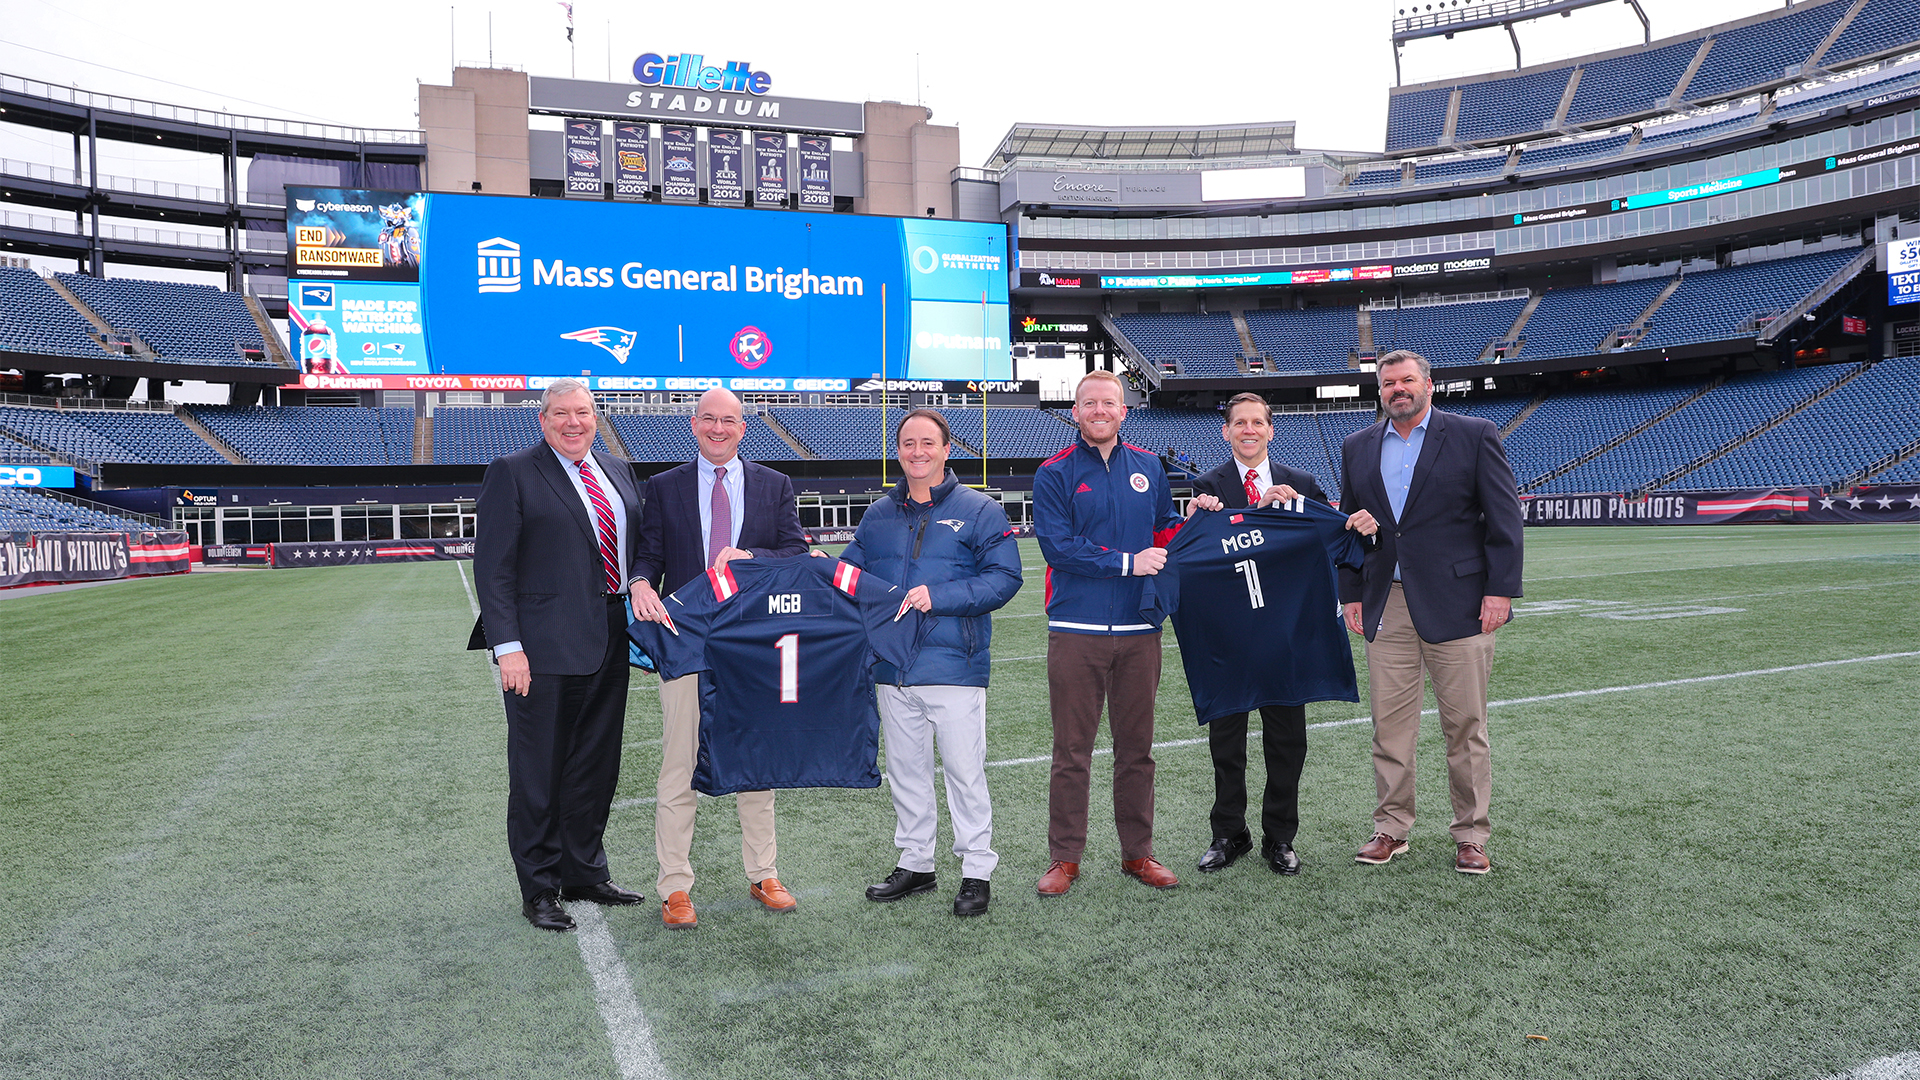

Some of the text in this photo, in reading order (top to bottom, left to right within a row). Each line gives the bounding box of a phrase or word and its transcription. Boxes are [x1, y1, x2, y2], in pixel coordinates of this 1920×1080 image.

[633, 52, 772, 96] Gillette
[626, 91, 780, 118] STADIUM
[1868, 96, 1888, 106] DELL
[1838, 143, 1919, 166] Mass General Brigham
[571, 182, 599, 191] 2001
[618, 185, 648, 194] 2003
[1053, 175, 1117, 192] Encore
[666, 187, 695, 196] 2004
[714, 190, 740, 198] 2014
[1668, 180, 1742, 200] Sports Medicine
[804, 195, 829, 203] 2018
[317, 202, 373, 213] cybereason
[1539, 212, 1561, 220] General
[1562, 209, 1586, 217] Brigham
[300, 230, 322, 242] END
[300, 250, 380, 263] RANSOMWARE
[942, 253, 1000, 263] GLOBALIZATION
[943, 261, 999, 270] PARTNERS
[1394, 263, 1439, 274] moderna
[1444, 258, 1490, 269] moderna
[533, 259, 863, 300] Mass General Brigham
[1115, 277, 1158, 287] Putnam
[1891, 272, 1920, 286] TEXT
[1898, 286, 1912, 294] TO
[342, 300, 417, 312] MADE FOR
[342, 311, 413, 322] PATRIOTS
[342, 322, 421, 334] WATCHING
[1024, 324, 1088, 333] DRAFTKINGS
[932, 333, 1001, 350] Putnam
[323, 376, 382, 388] Putnam
[407, 377, 462, 388] TOYOTA
[470, 377, 524, 388] TOYOTA
[529, 377, 589, 389] GEO
[598, 378, 657, 390] GEICO
[665, 378, 722, 390] GEICO
[730, 378, 786, 390] GEICO
[793, 379, 848, 390] GEICO
[887, 381, 943, 391] EMPOWER
[1536, 498, 1601, 520] ENGLAND
[1609, 497, 1684, 518] PATRIOTS
[1221, 529, 1264, 554] MGB
[67, 541, 127, 572] PATRIOTS
[1234, 558, 1264, 610] 1
[768, 594, 801, 615] MGB
[774, 634, 799, 703] 1
